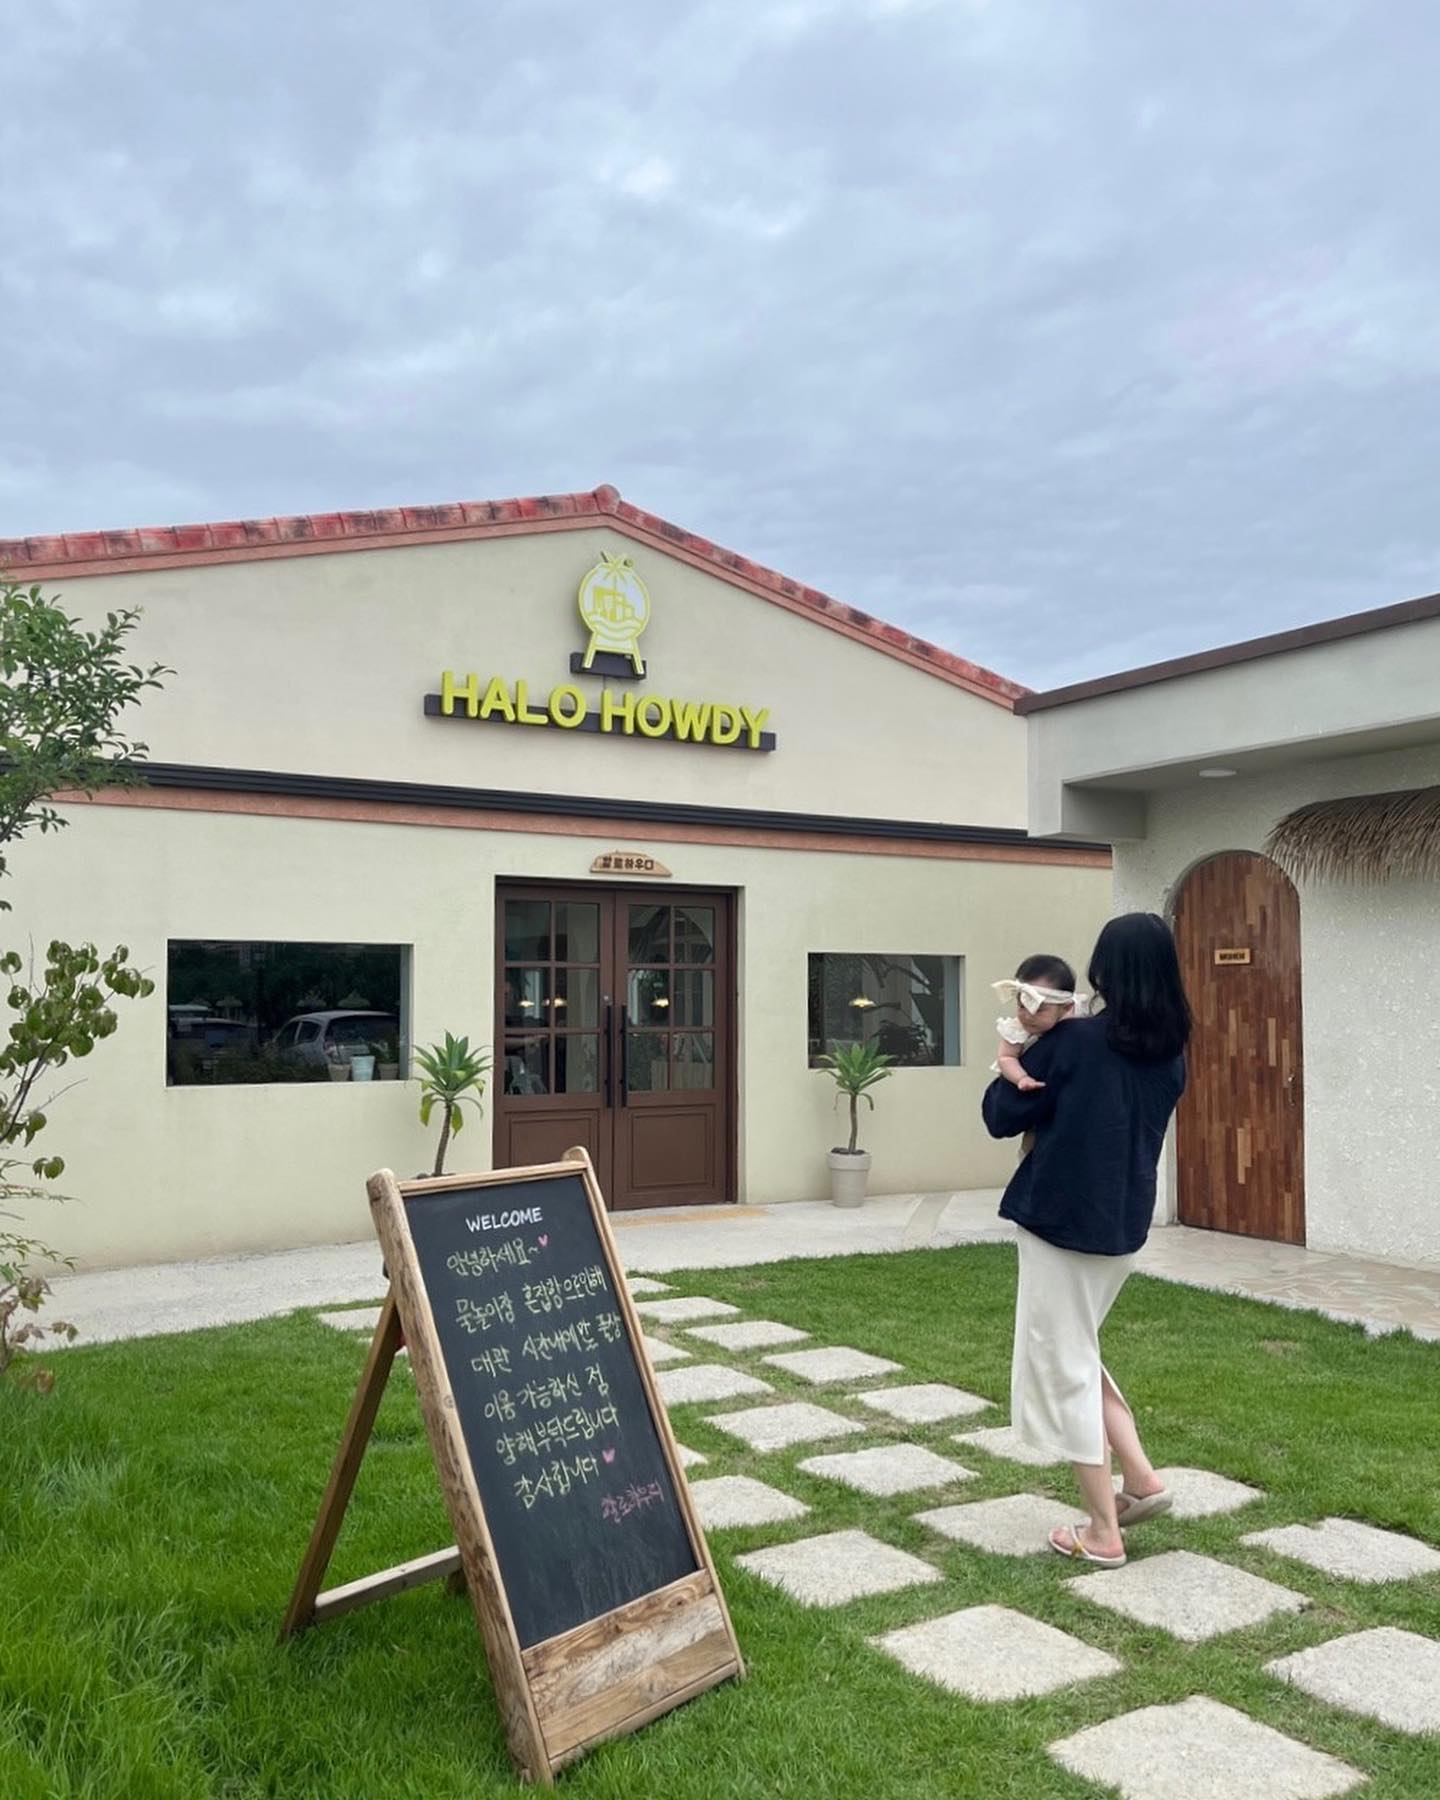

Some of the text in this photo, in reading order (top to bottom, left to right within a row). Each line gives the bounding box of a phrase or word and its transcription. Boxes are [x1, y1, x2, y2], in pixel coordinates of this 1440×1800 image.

[441, 671, 769, 749] HALO HOWDY
[466, 1207, 543, 1232] WELCOME
[456, 1292, 515, 1333] 물놀이장
[471, 1346, 512, 1378] 대관
[484, 1363, 609, 1422] 이용 가능하신 점
[513, 1454, 600, 1509] 감사합니다
